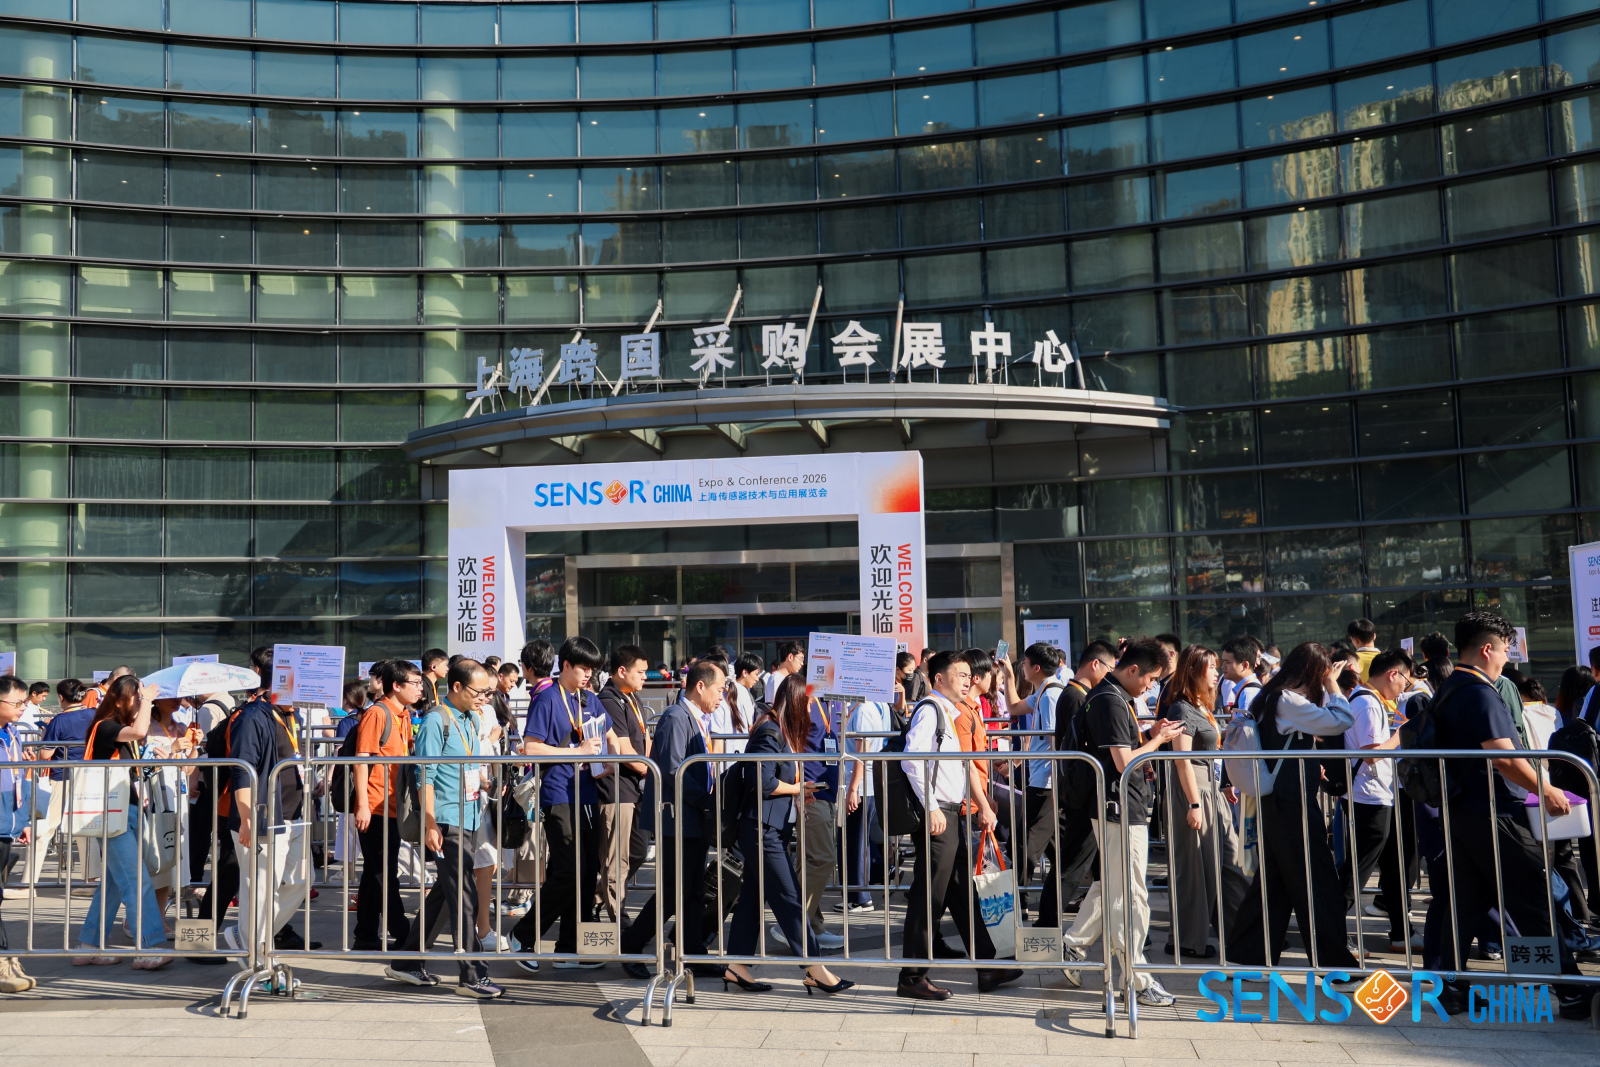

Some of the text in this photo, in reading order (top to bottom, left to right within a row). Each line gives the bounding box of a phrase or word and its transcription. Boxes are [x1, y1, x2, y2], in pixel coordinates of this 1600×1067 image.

[466, 320, 1074, 400] 上海跨国采购会展中心
[698, 473, 827, 489] Expo & Conference 2026
[653, 483, 692, 503] CHINA
[698, 488, 828, 502] 上海传感器技术与应用展览会
[870, 544, 893, 634] 欢迎光临
[897, 543, 913, 633] WELCOME
[457, 556, 477, 642] 欢迎光临
[482, 555, 495, 642] WELCOME
[181, 928, 209, 942] 跨采
[583, 931, 614, 947] 跨采
[1023, 937, 1057, 953] 跨采
[1510, 944, 1554, 965] 跨采
